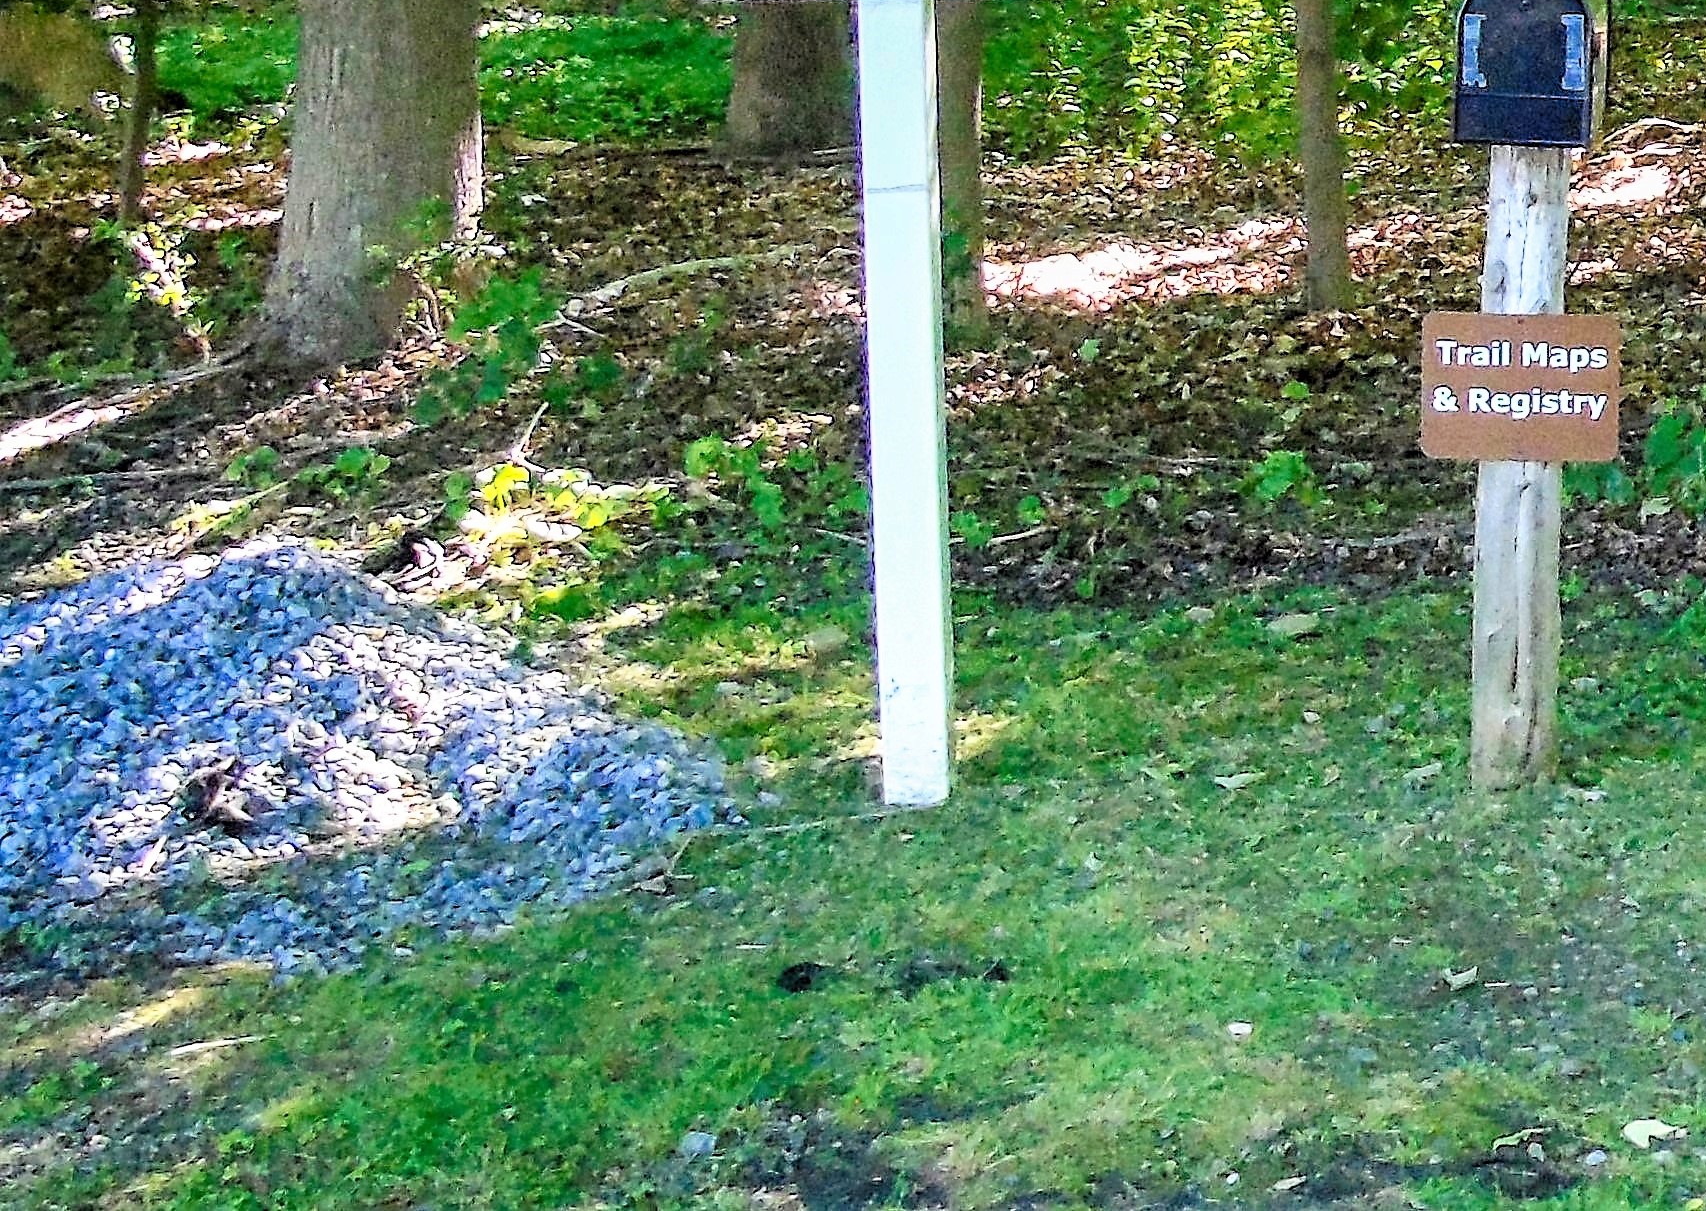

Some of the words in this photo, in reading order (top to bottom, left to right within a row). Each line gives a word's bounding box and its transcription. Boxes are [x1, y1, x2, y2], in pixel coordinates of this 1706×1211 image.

[1435, 339, 1511, 366] Trail
[1521, 341, 1608, 374] Maps
[1432, 385, 1460, 412] &
[1467, 387, 1607, 421] Registry
